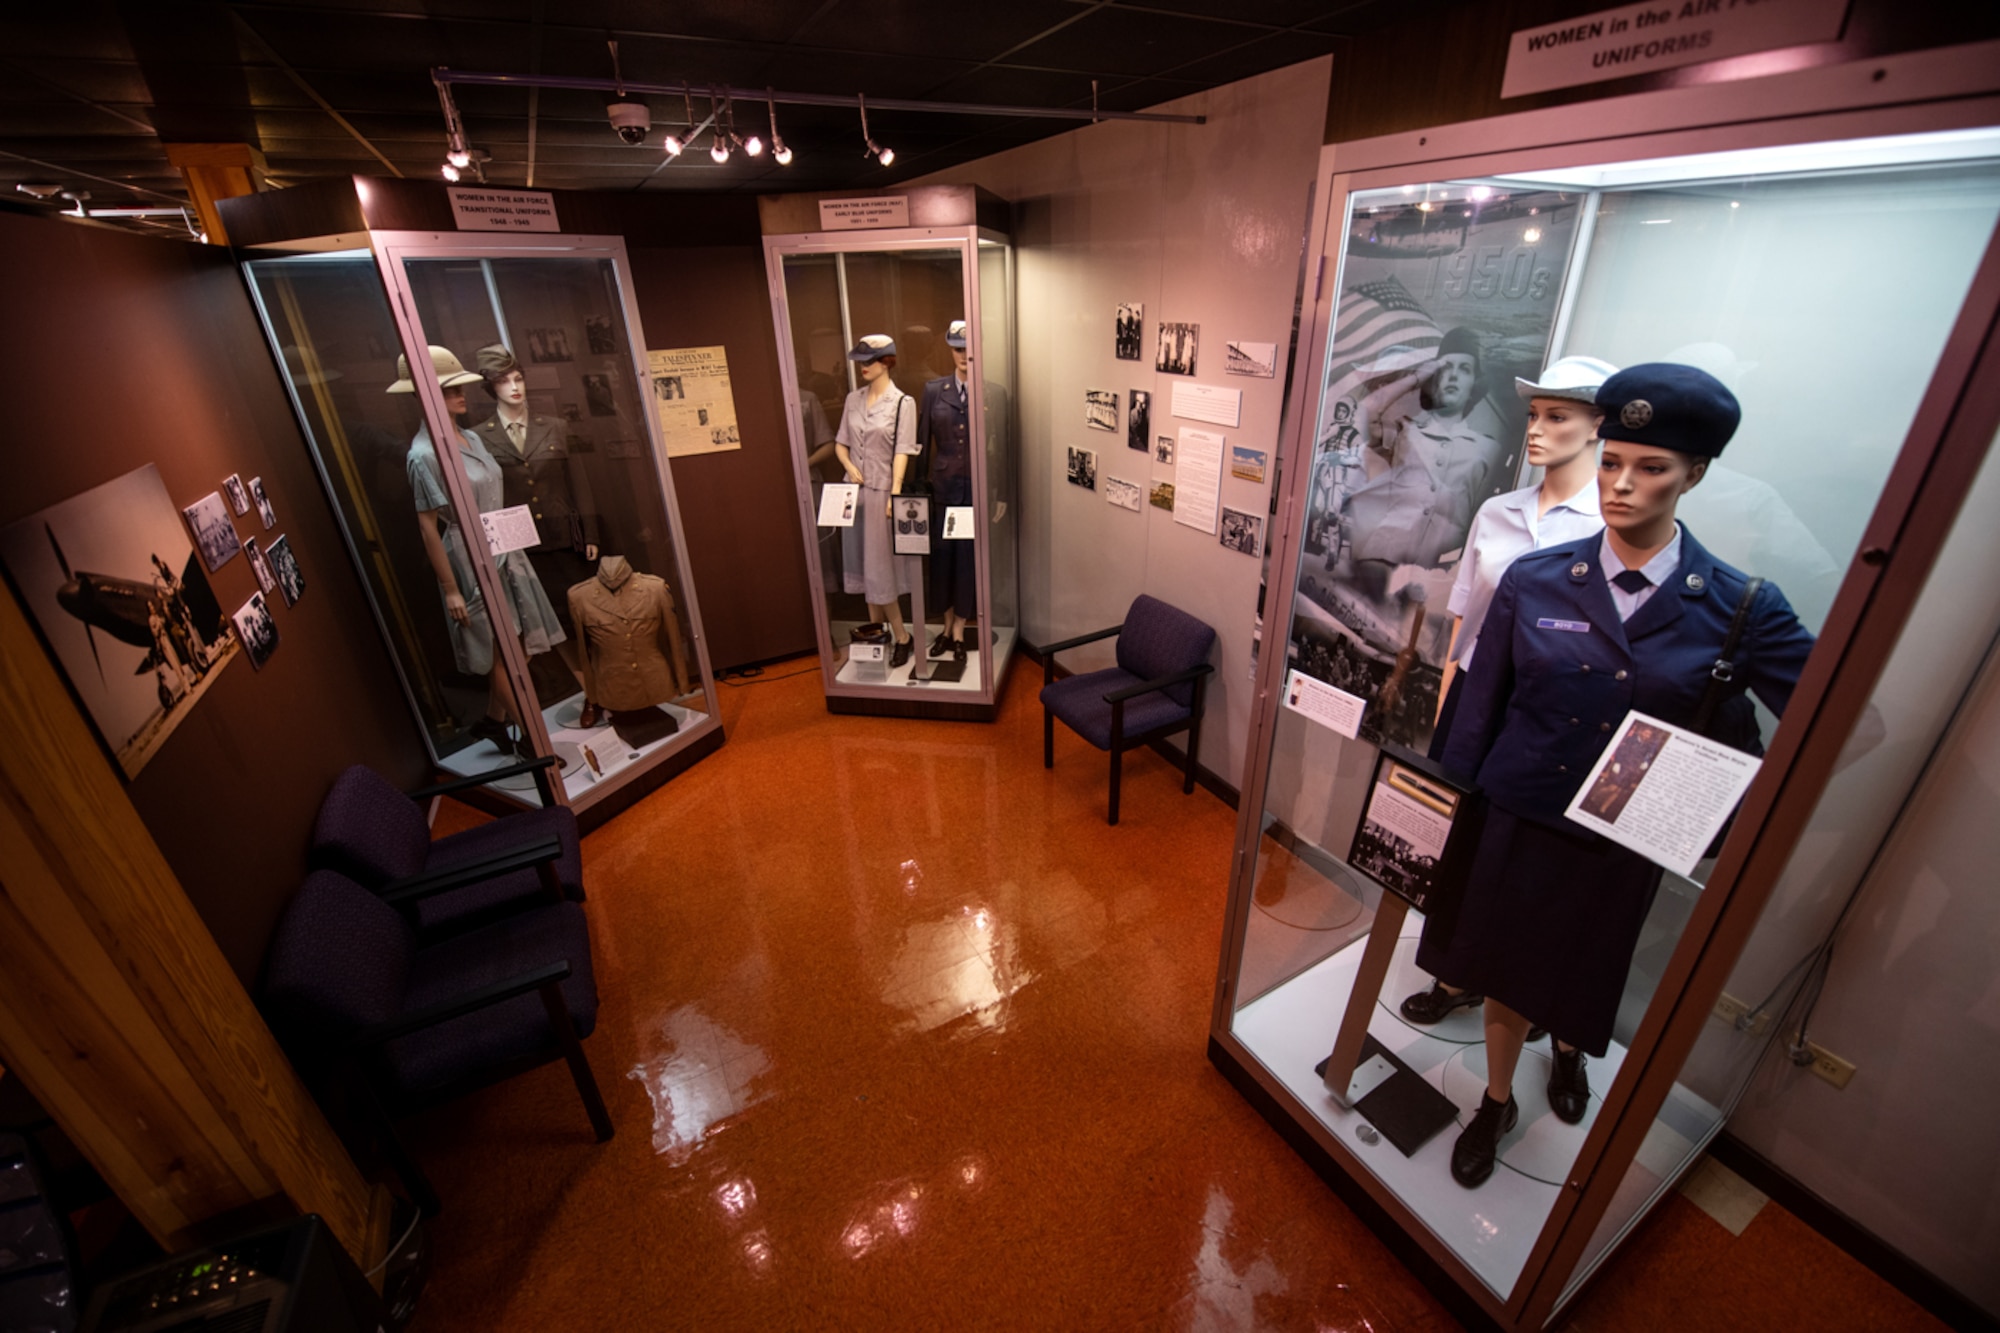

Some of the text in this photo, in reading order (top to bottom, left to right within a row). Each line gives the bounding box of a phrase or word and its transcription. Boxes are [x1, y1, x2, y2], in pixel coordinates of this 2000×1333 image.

[1528, 22, 1604, 52] WOMEN
[1609, 17, 1629, 34] in
[1635, 8, 1673, 29] the
[1678, 0, 1721, 20] AIR
[1592, 29, 1713, 69] UNIFORMS
[456, 193, 484, 201] WOMEN
[496, 195, 511, 203] THE
[526, 197, 549, 205] FORCE
[459, 205, 551, 216] TRANSITIONAL UNIFORMS
[1425, 246, 1551, 300] 1950s
